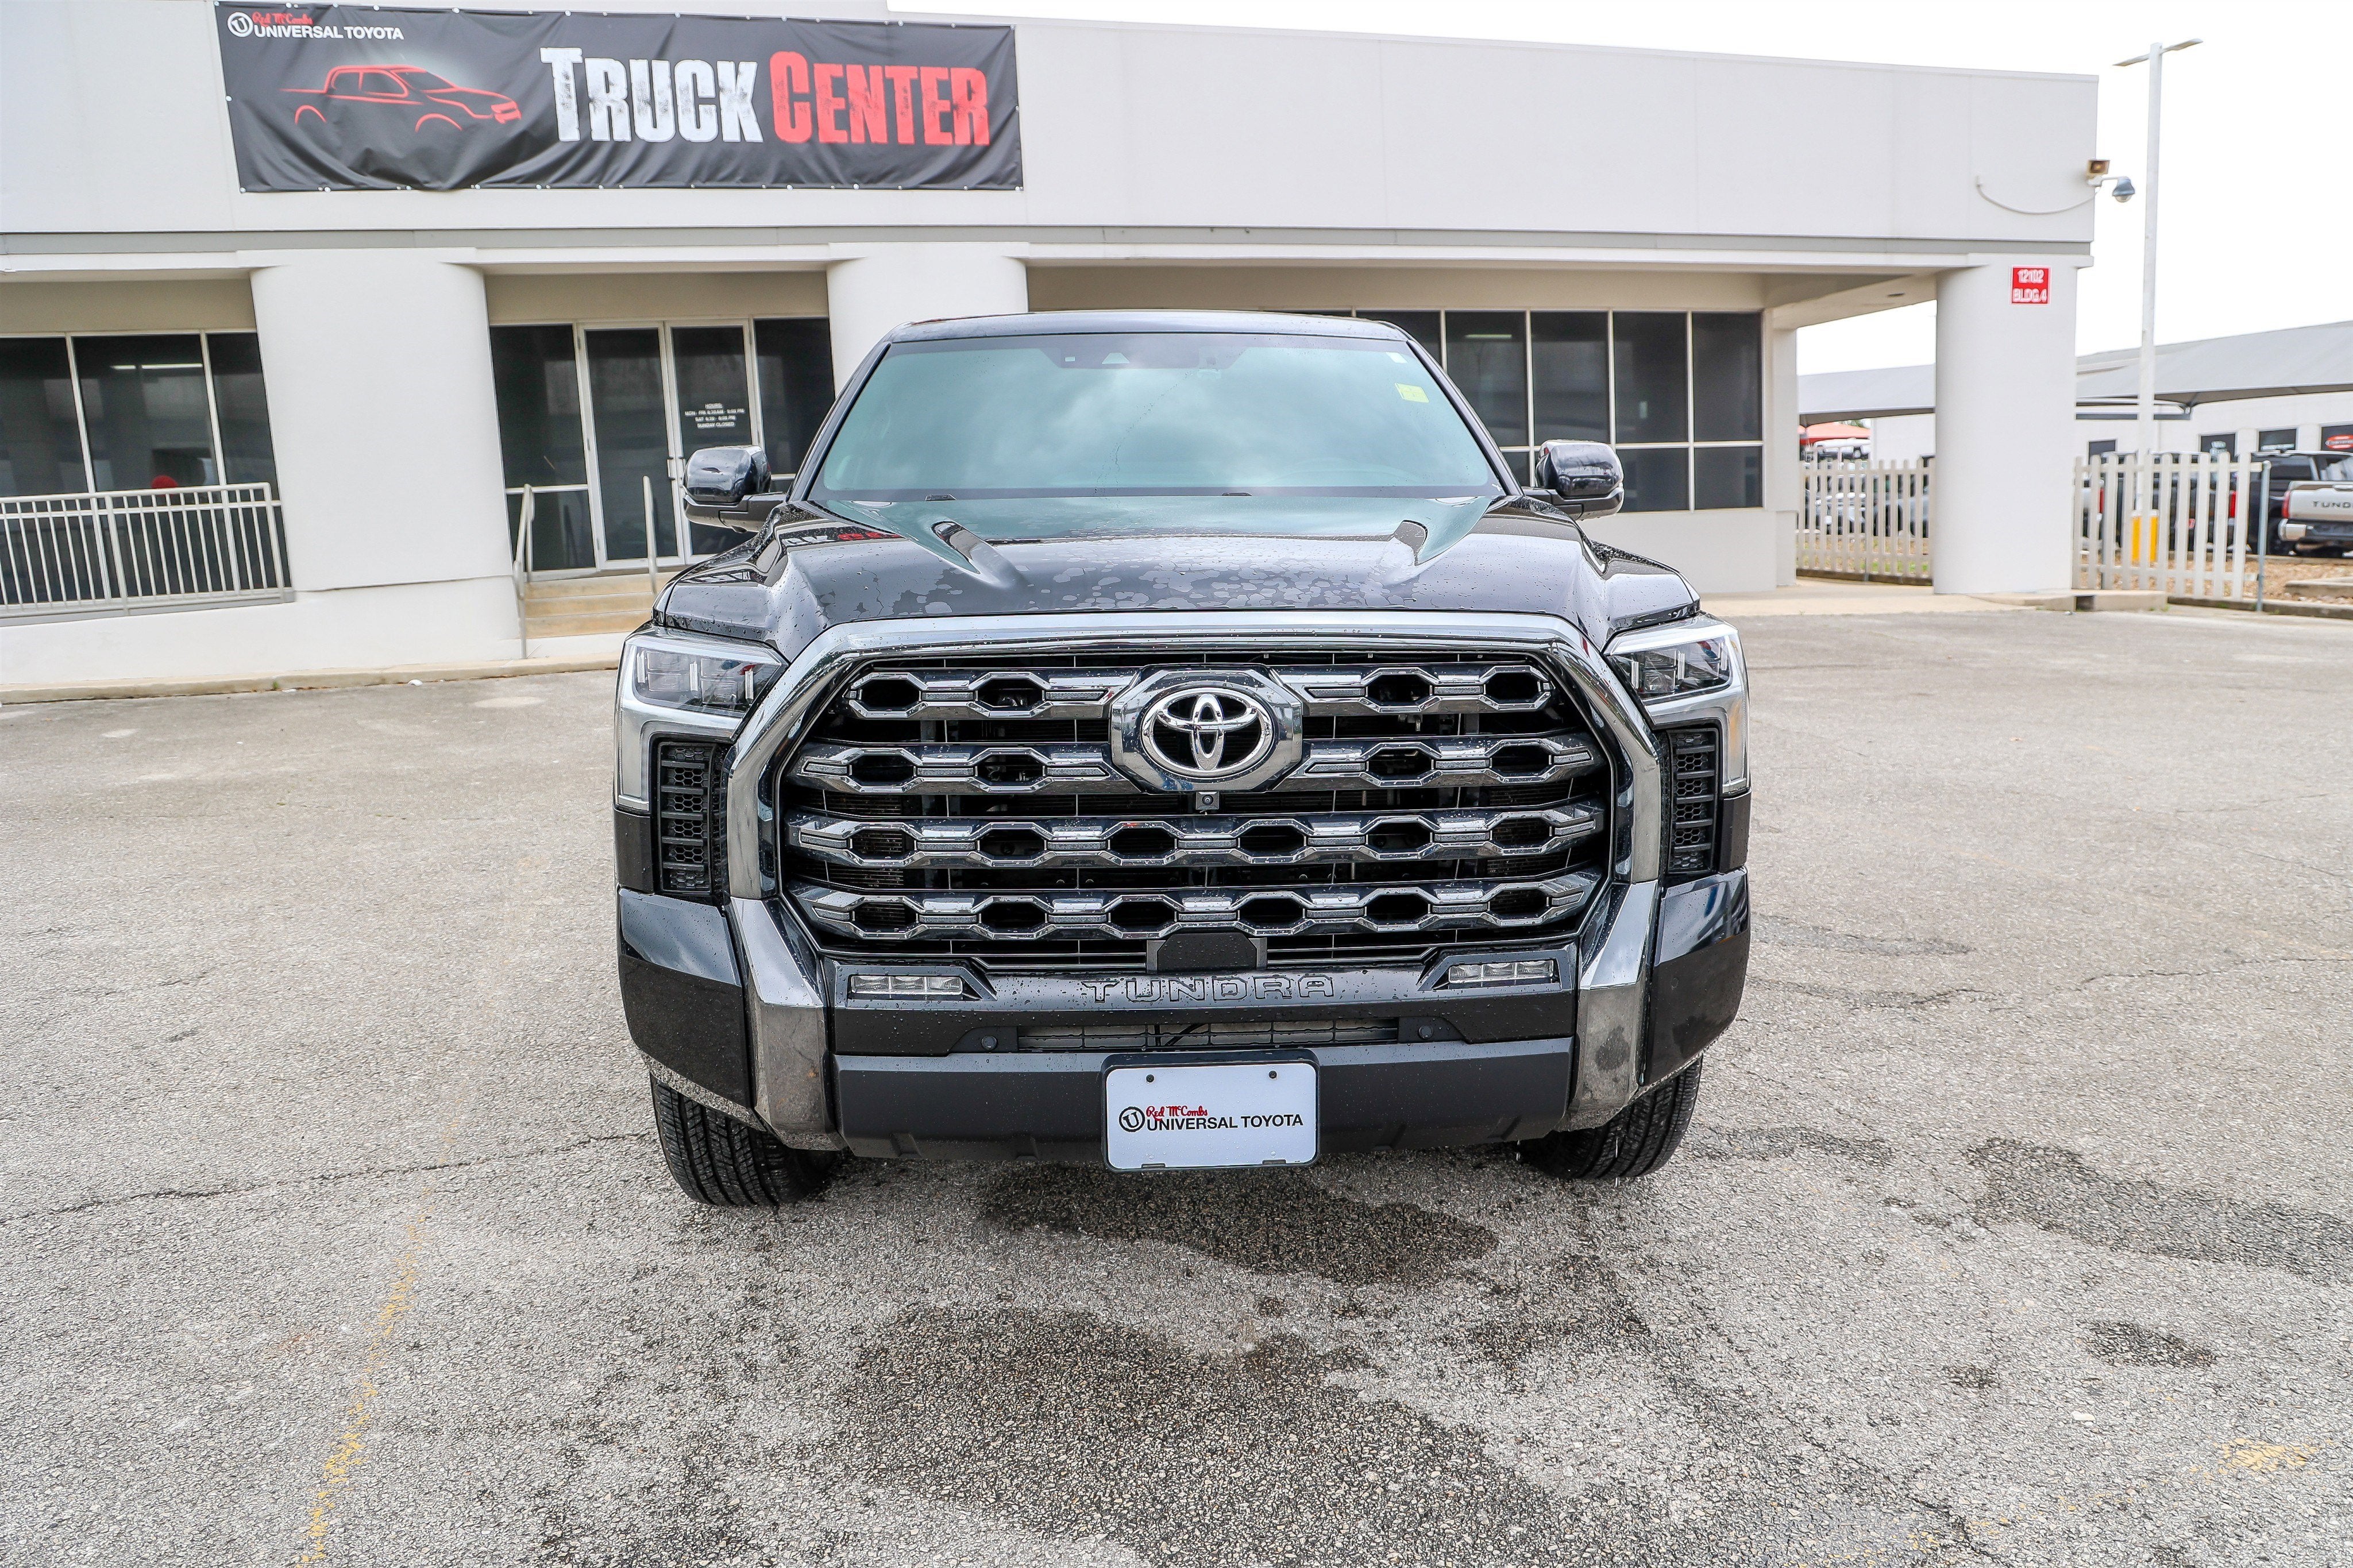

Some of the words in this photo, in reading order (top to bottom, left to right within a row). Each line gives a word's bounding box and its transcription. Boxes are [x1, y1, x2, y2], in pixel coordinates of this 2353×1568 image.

[253, 24, 344, 38] UNIVERSAL
[344, 26, 404, 40] TOYOTA
[540, 47, 763, 143] TRUCK
[769, 51, 990, 146] CENTER
[2017, 269, 2045, 284] 12102
[1081, 975, 1333, 1003] TUNDRA
[1145, 1106, 1165, 1121] Red
[1166, 1106, 1208, 1117] McCombs
[1147, 1117, 1238, 1131] UNIVERSAL
[1241, 1114, 1303, 1127] TOYOTA
